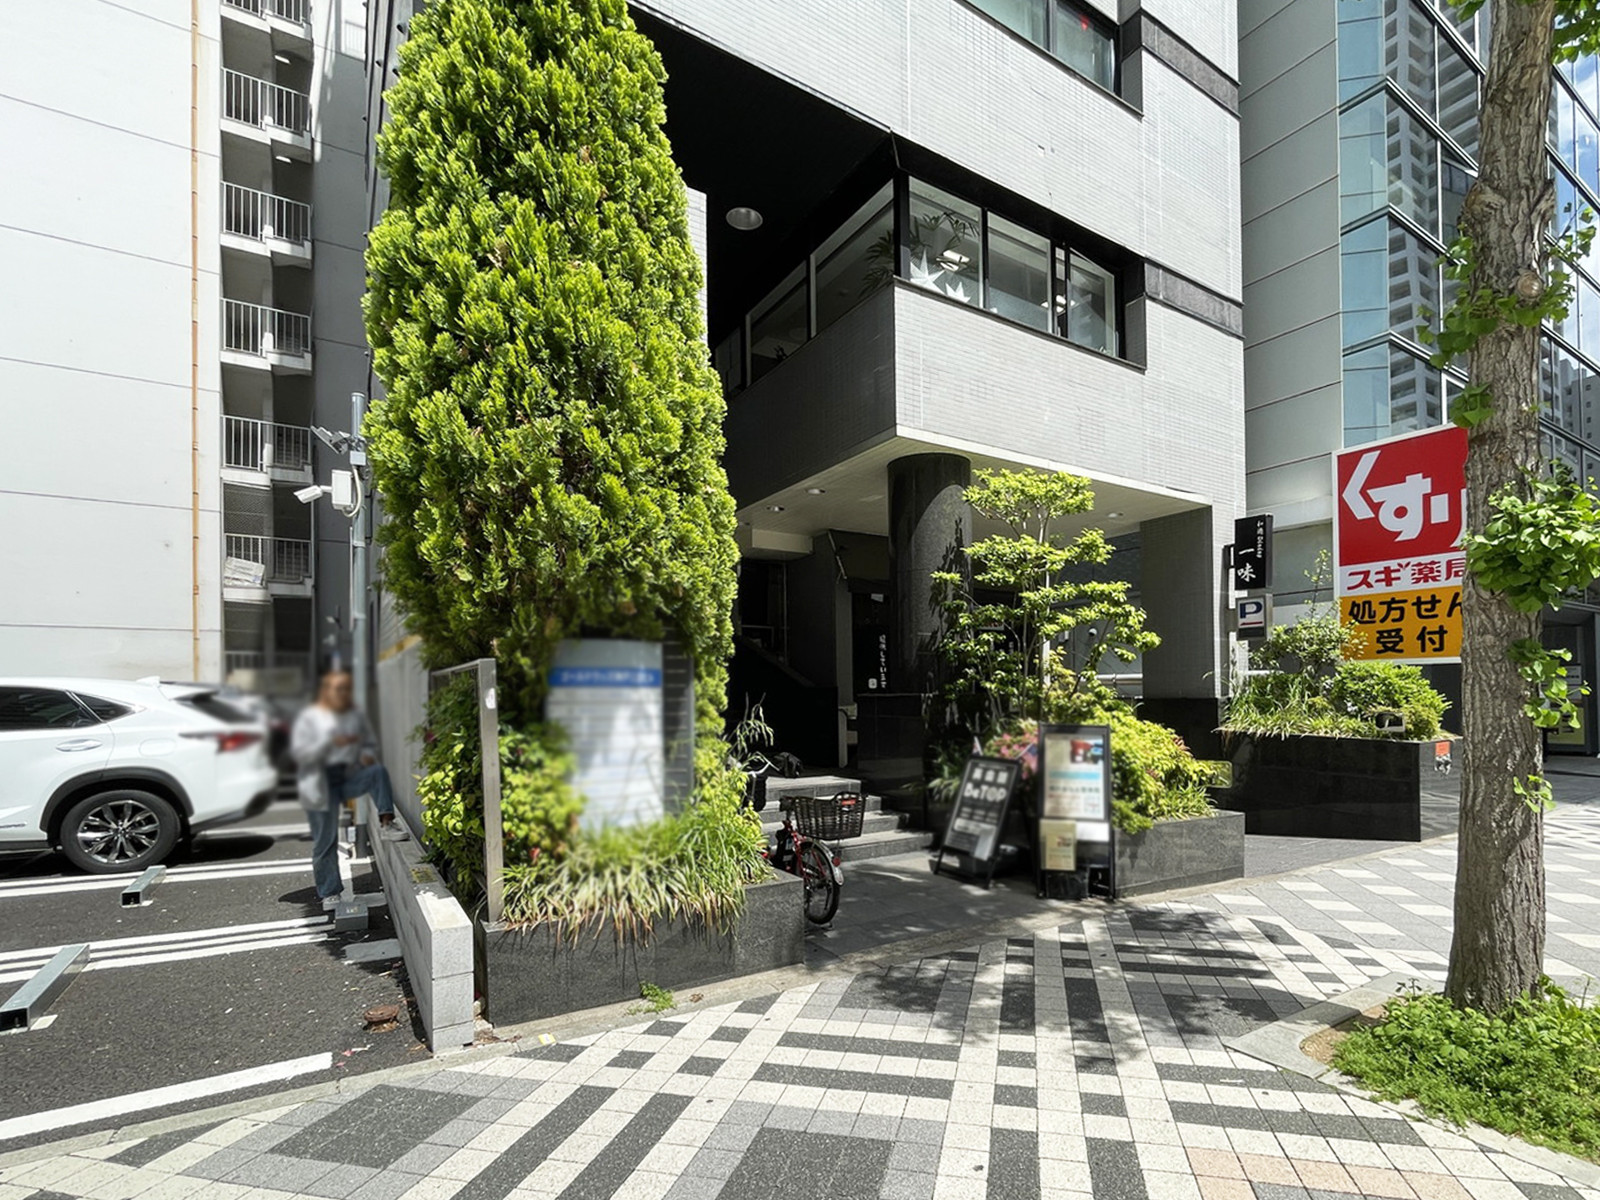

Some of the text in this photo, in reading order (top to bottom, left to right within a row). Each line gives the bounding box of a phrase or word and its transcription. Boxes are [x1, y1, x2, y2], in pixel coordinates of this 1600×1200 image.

[1237, 547, 1256, 582] 一味
[1240, 601, 1263, 619] P
[1376, 624, 1448, 655] 受付
